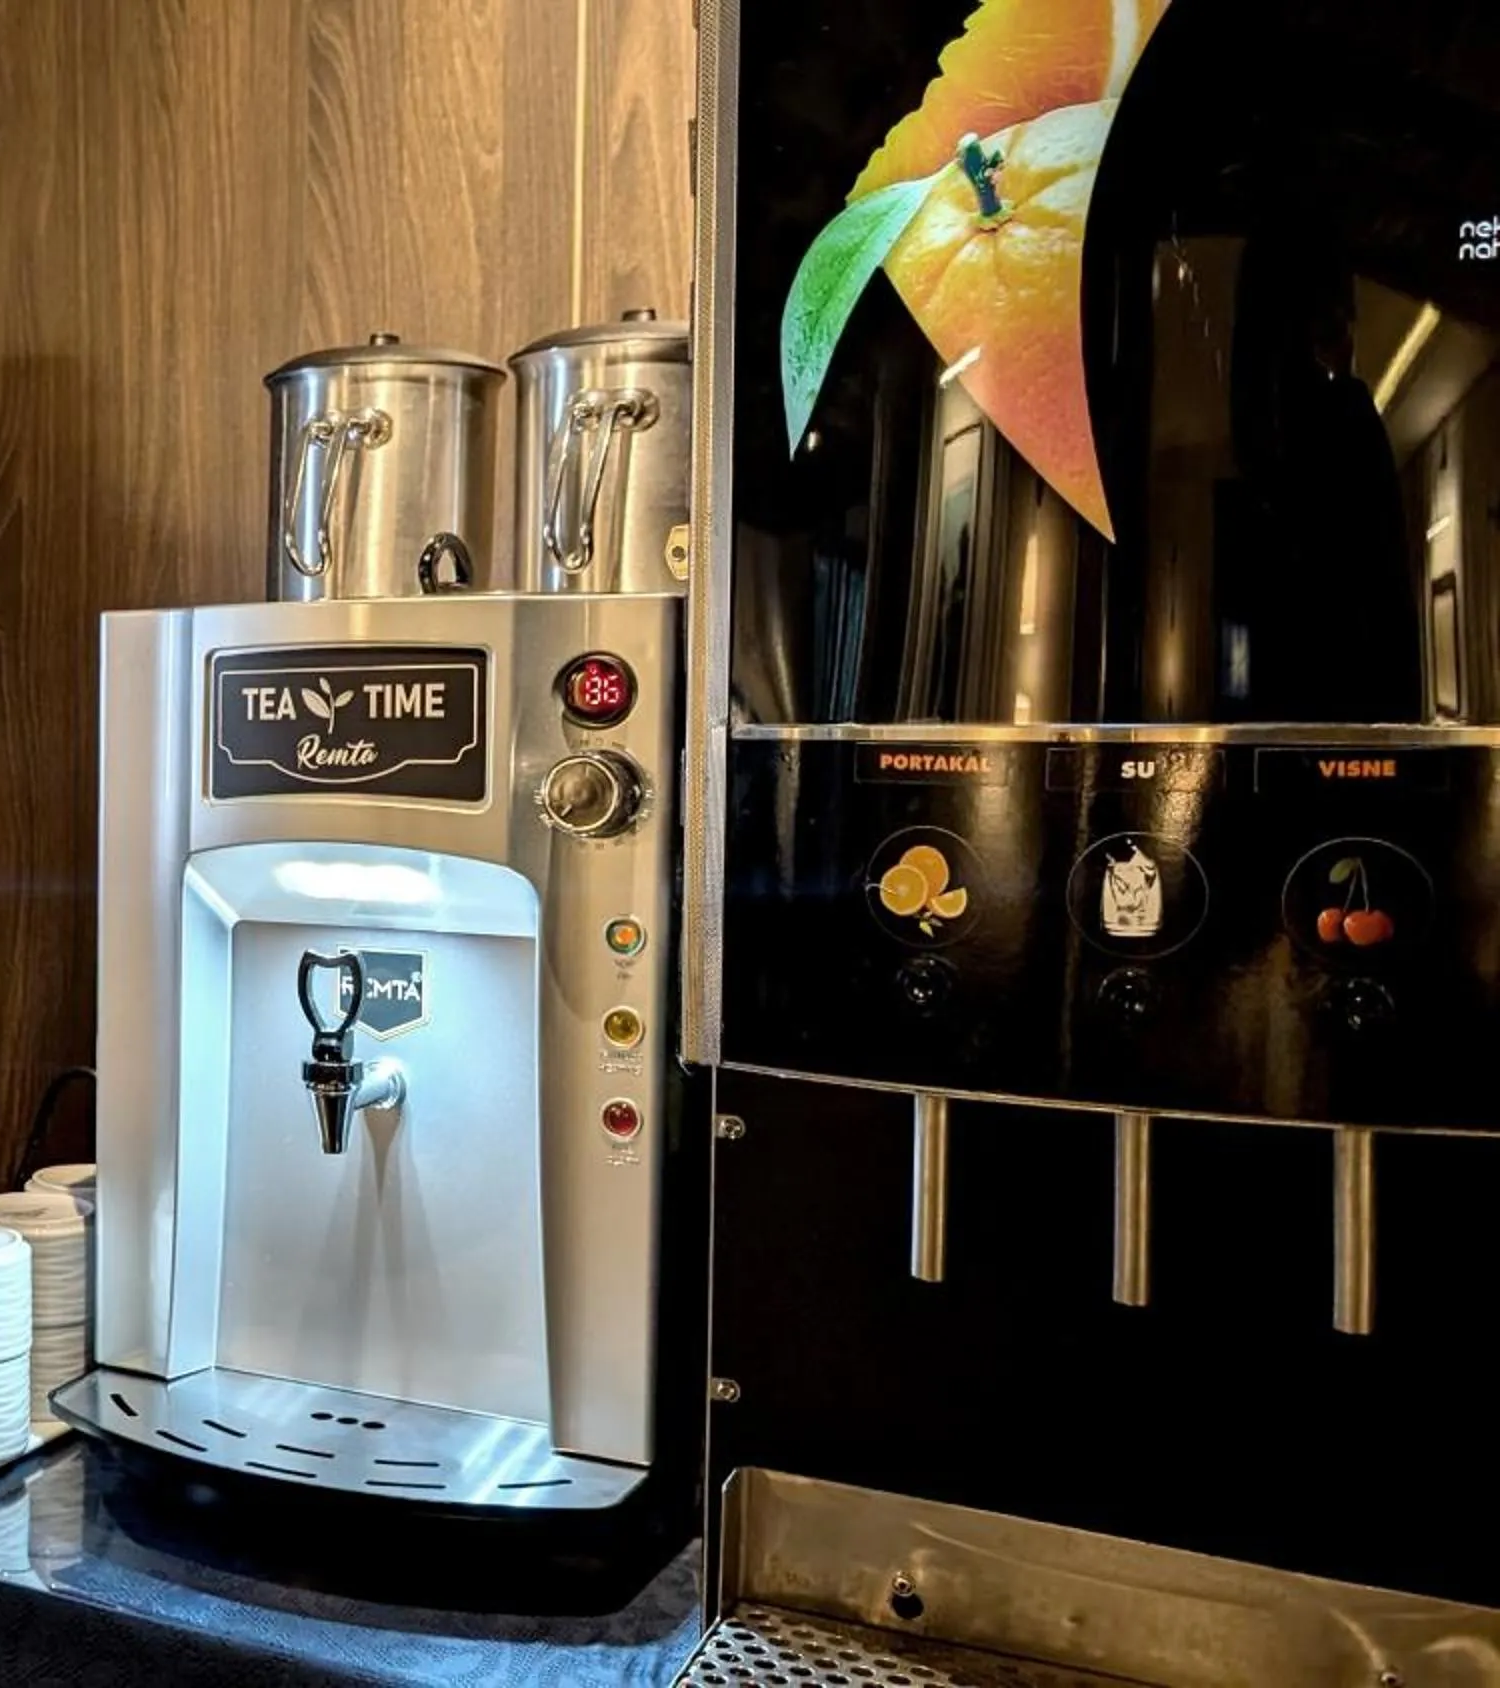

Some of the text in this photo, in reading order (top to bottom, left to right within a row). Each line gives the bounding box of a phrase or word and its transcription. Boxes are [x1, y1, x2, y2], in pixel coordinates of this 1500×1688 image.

[241, 683, 446, 721] TEA TIME
[296, 733, 379, 771] Remta
[879, 753, 992, 772] PORTAKAL
[1121, 761, 1155, 779] SU
[1317, 759, 1397, 778] VISNE
